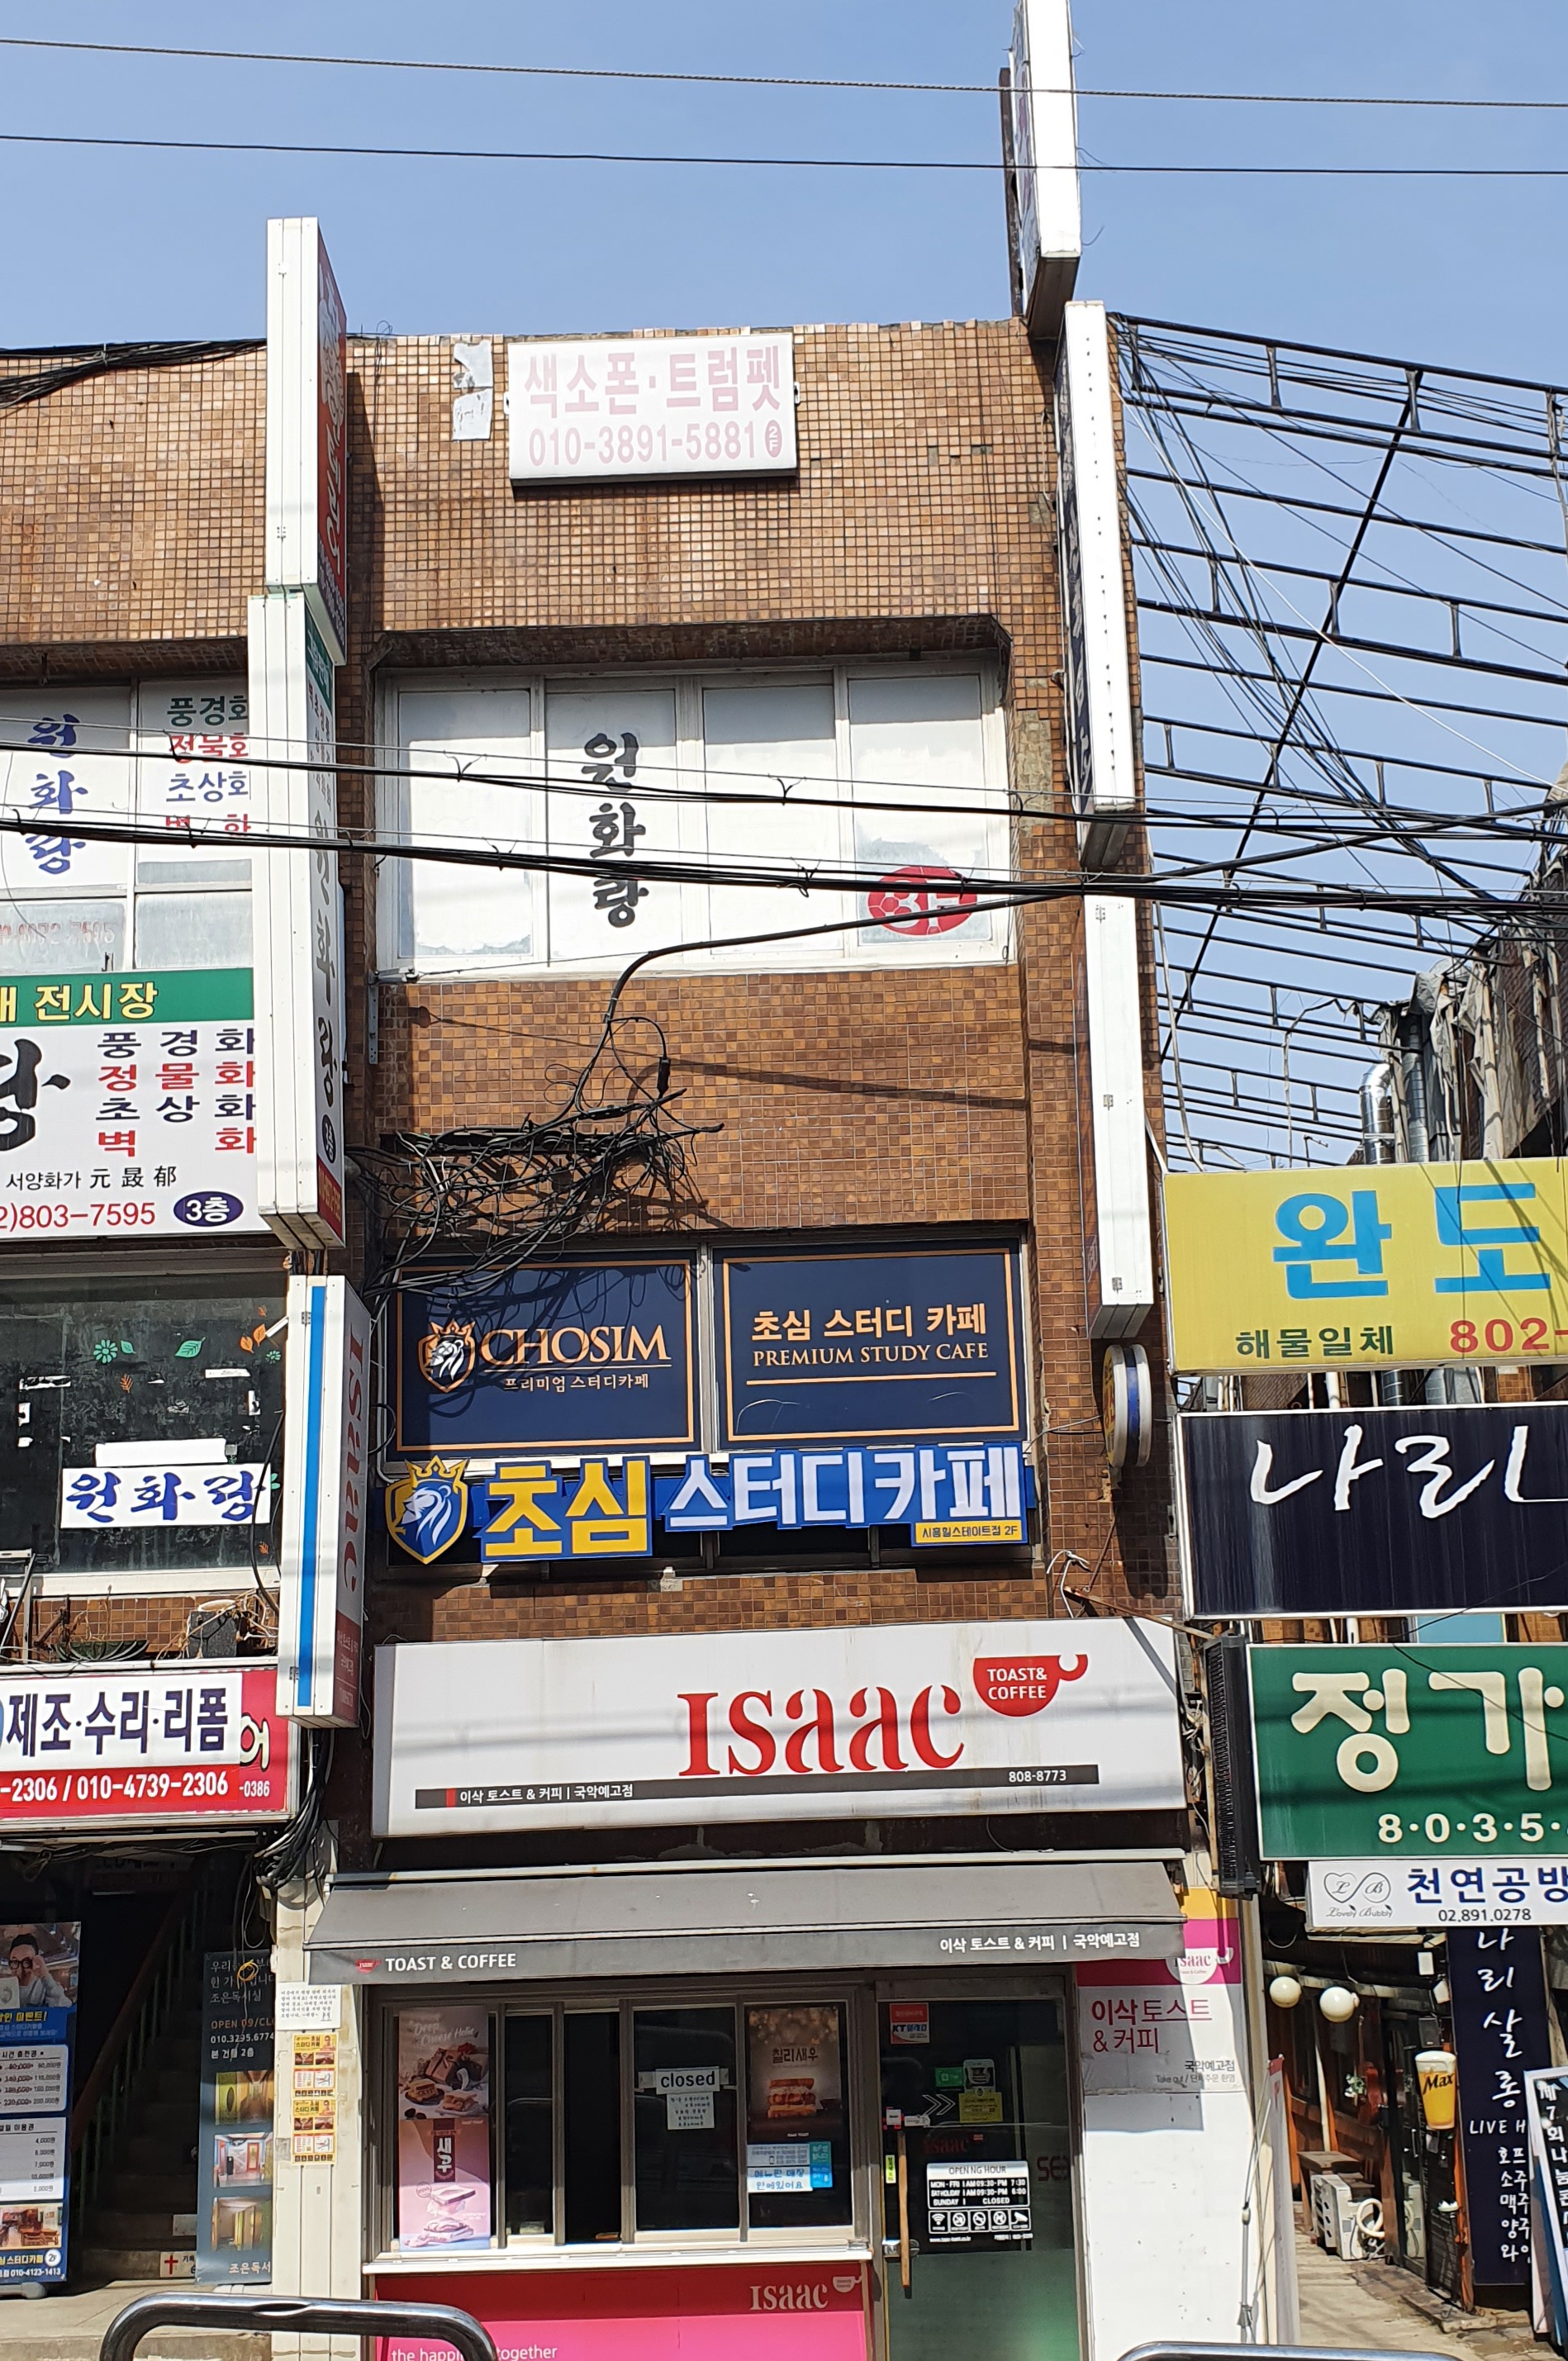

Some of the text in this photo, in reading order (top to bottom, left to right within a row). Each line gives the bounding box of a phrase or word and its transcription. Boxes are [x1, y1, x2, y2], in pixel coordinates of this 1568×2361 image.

[529, 420, 755, 467] 010-3891-5881
[581, 732, 649, 929] 원화랑
[35, 981, 159, 1021] 전시장
[6, 1170, 82, 1191] 서양화가
[186, 1199, 230, 1223] 3층
[1272, 1183, 1551, 1299] 완도
[752, 1303, 986, 1341] 초심 스터디 카페
[480, 1324, 672, 1365] CHOSIM
[1235, 1325, 1394, 1359] 해물일체
[753, 1342, 988, 1366] PREMIUM STUDY CAFE
[503, 1374, 649, 1392] 프리미엄 스터디카페
[66, 1471, 265, 1523] 원화랑
[485, 1445, 1021, 1556] 초심 스터디카페
[1005, 1525, 1018, 1536] 2F
[988, 1685, 1047, 1700] COFFEE
[77, 1770, 229, 1800] 010-4739-2306
[1009, 1770, 1067, 1782] 808-8773
[460, 1784, 634, 1803] 이삭 토스트 & 커피 국악예고점
[1407, 1867, 1568, 1903] 천연공방
[1438, 1908, 1532, 1922] 02.891.0278
[940, 1932, 1140, 1953] 이삭 토스트 & 커피 국악예고점
[385, 1953, 516, 1972] TOAST & COFFEE
[211, 2021, 237, 2030] OPEN
[1093, 2028, 1158, 2054] & 커피
[1185, 2060, 1235, 2072] 국악예고점
[661, 2070, 715, 2088] closed
[1423, 2073, 1455, 2094] Max
[1470, 2119, 1507, 2134] LIVE
[1498, 2147, 1526, 2164] 호프
[985, 2165, 1006, 2174] HOUR
[1501, 2170, 1528, 2192] 소주
[1499, 2192, 1529, 2215] 맥주
[1501, 2217, 1530, 2240] 양주
[392, 2349, 414, 2361] the
[420, 2348, 463, 2361] happi
